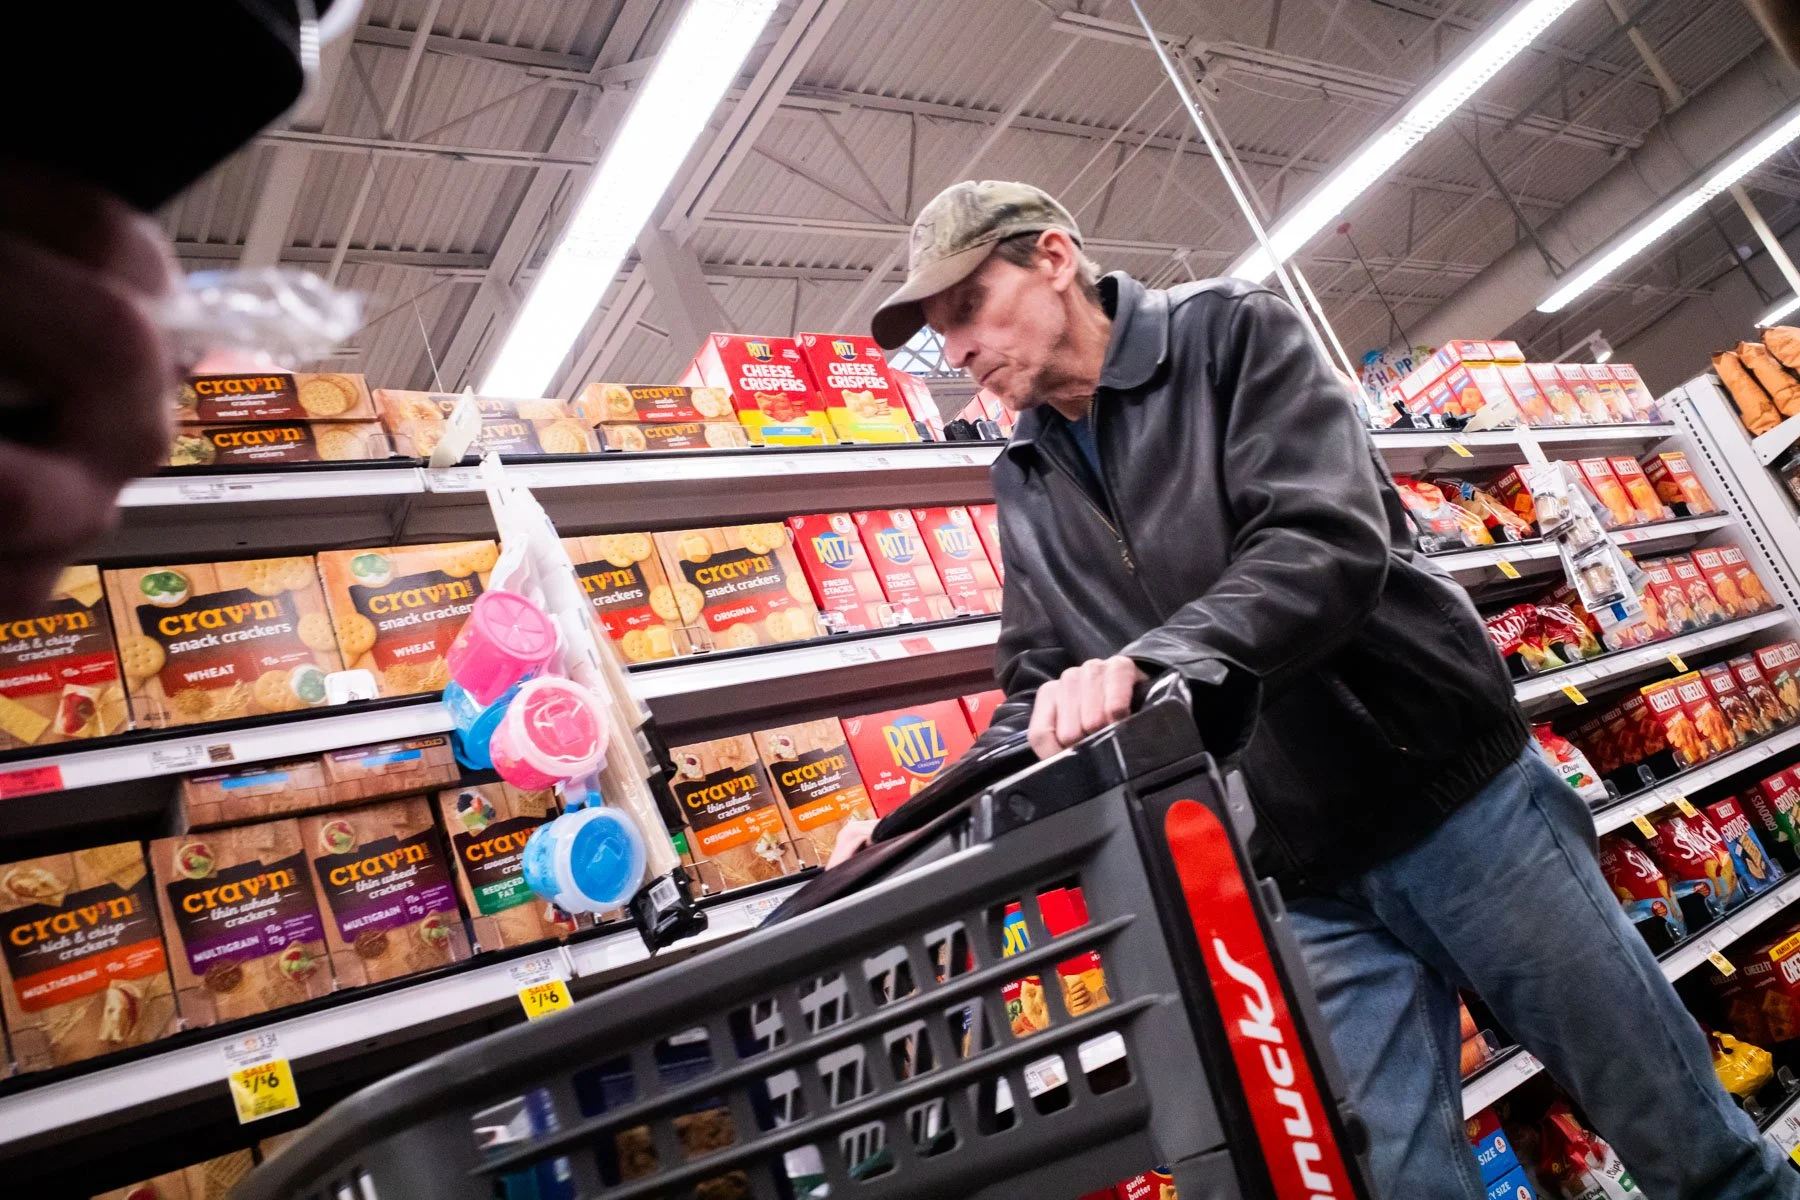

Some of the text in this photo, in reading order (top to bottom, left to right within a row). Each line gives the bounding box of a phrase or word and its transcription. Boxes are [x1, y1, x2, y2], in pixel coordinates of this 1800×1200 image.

[745, 340, 774, 362] RITZ
[832, 339, 858, 361] RITZ
[742, 363, 795, 379] CHEESE
[829, 361, 877, 377] CHEESE
[195, 377, 283, 396] crav'n
[740, 377, 807, 392] CRISPERS
[827, 375, 889, 390] CRISPERS
[631, 386, 685, 401] crav'n
[213, 427, 300, 448] crav'n
[644, 423, 699, 439] crav'n
[811, 537, 854, 564] RITZ
[874, 532, 915, 559] RITZ
[933, 528, 972, 554] RITZ
[696, 556, 770, 585] crav'n
[886, 573, 911, 582] FRESH
[944, 567, 969, 576] FRESH
[945, 573, 973, 582] STACKS
[705, 574, 781, 599] snack crackers
[822, 578, 850, 588] FRESH
[823, 585, 855, 596] STACKS
[888, 579, 916, 589] STACKS
[368, 581, 468, 614] crav'n
[593, 588, 644, 606] crackers
[158, 599, 278, 636] crav'n
[379, 603, 474, 631] snack cracker
[714, 605, 757, 622] ORIGINAL
[0, 610, 89, 641] rav'n
[169, 622, 292, 654] snack crackers
[18, 647, 74, 662] crackers
[393, 640, 436, 658] WHEAT
[0, 672, 52, 688] RIGINAL
[183, 664, 235, 684] WHEAT
[882, 720, 950, 767] RITZ
[781, 753, 845, 786] crav'n
[879, 770, 892, 780] the
[686, 774, 757, 808] crav'n
[800, 772, 843, 794] thin wheat
[810, 783, 841, 799] crackers
[873, 776, 906, 793] original
[706, 792, 753, 815] thin wheat
[717, 803, 751, 820] crackers
[798, 804, 834, 822] ORIGINAL
[1752, 795, 1778, 832] GROOVES
[703, 827, 743, 846] ORIGINAL
[1720, 813, 1751, 843] GROOVES
[466, 825, 535, 862] crav'
[328, 843, 424, 887] crav'n
[502, 862, 524, 875] crac
[355, 864, 418, 893] thin wheat
[482, 877, 524, 897] REDUCED
[182, 871, 291, 914] crav'n
[368, 879, 415, 900] crackers
[498, 887, 516, 900] FAT
[209, 891, 283, 922] thin wheat
[9, 896, 134, 946] crav'n
[224, 908, 278, 929] crackers
[343, 905, 401, 932] MULTIGRAIN
[74, 931, 85, 943] &
[58, 937, 119, 962] crackers
[193, 935, 260, 963] MULTIGRAIN
[22, 968, 99, 999] MULTIGRAIN
[1000, 982, 1019, 994] able
[1477, 1147, 1498, 1166] SIZE
[1125, 1174, 1146, 1193] garlic
[1127, 1185, 1151, 1200] butter
[1495, 1181, 1512, 1197] SIZE
